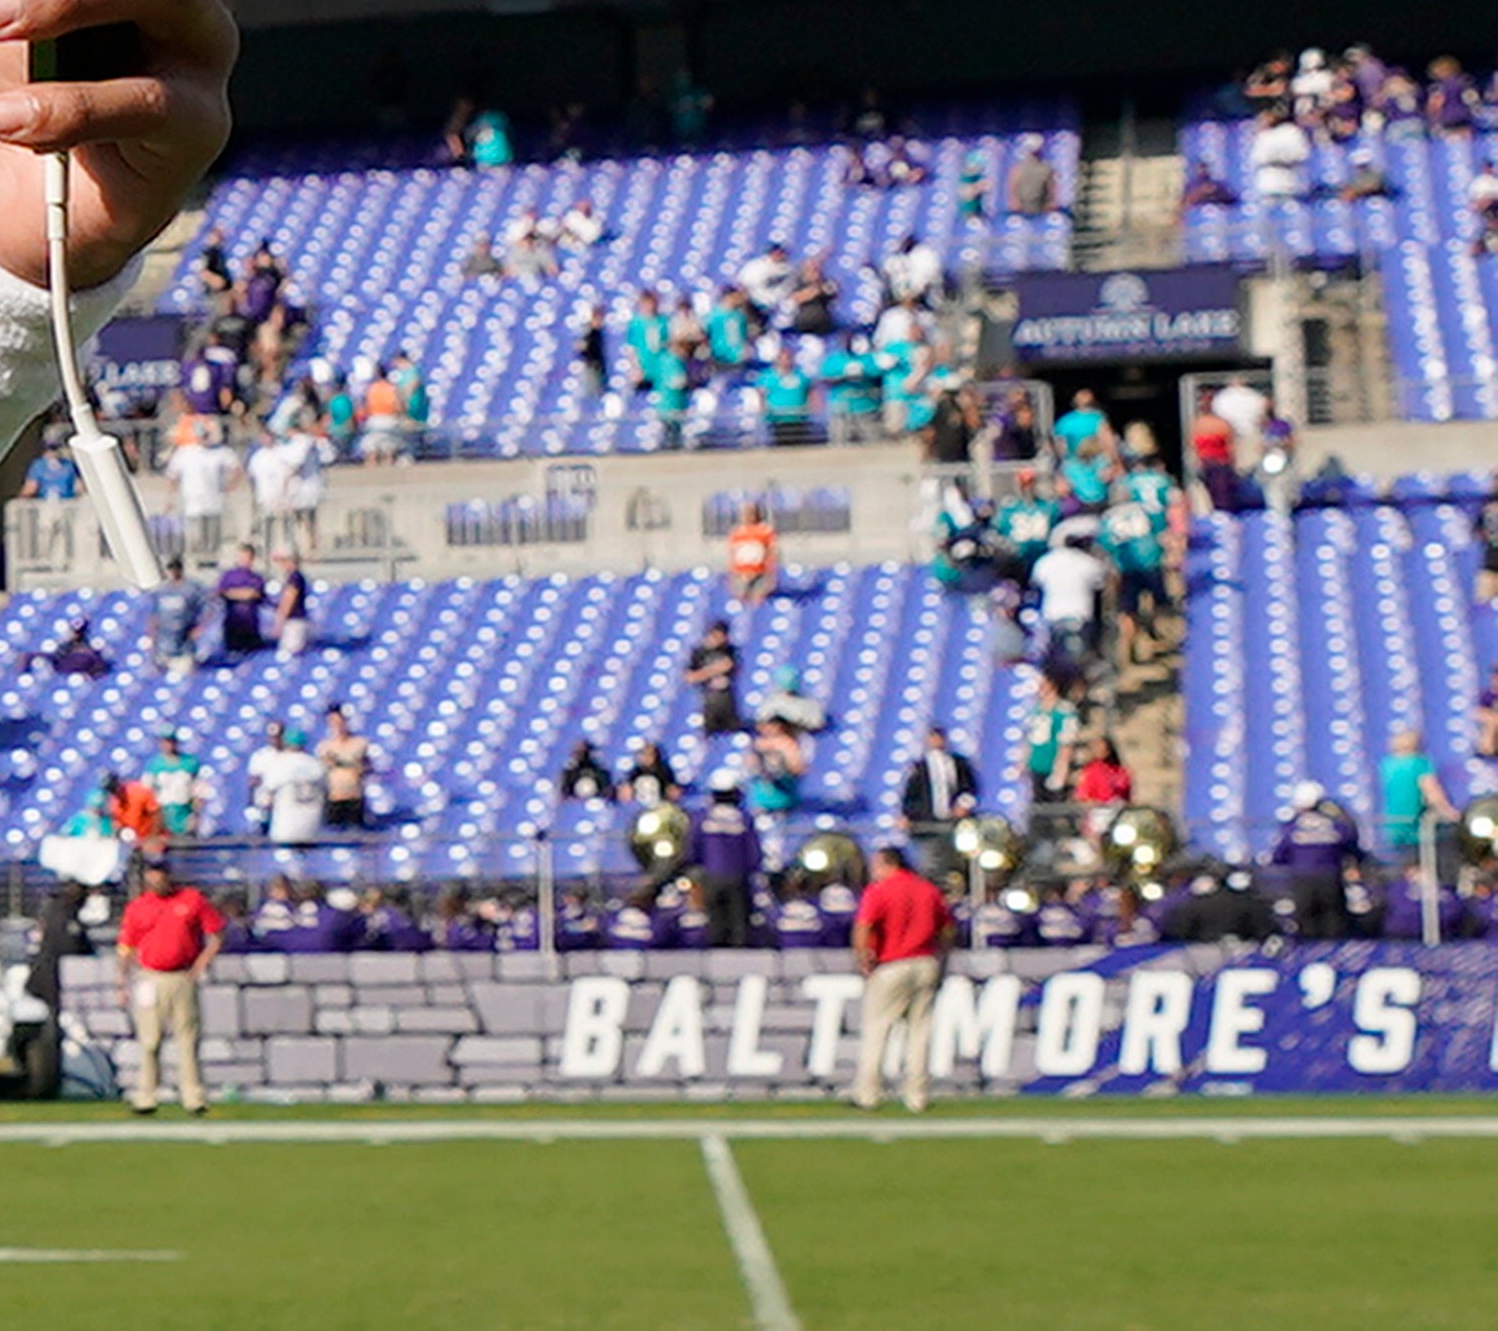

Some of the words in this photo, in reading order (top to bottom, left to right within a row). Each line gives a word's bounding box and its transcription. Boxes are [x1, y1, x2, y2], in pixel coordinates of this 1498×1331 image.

[1011, 314, 1151, 347] AUTUMN
[1153, 308, 1241, 341] LAKE
[558, 965, 1424, 1076] BALTMORE'S
